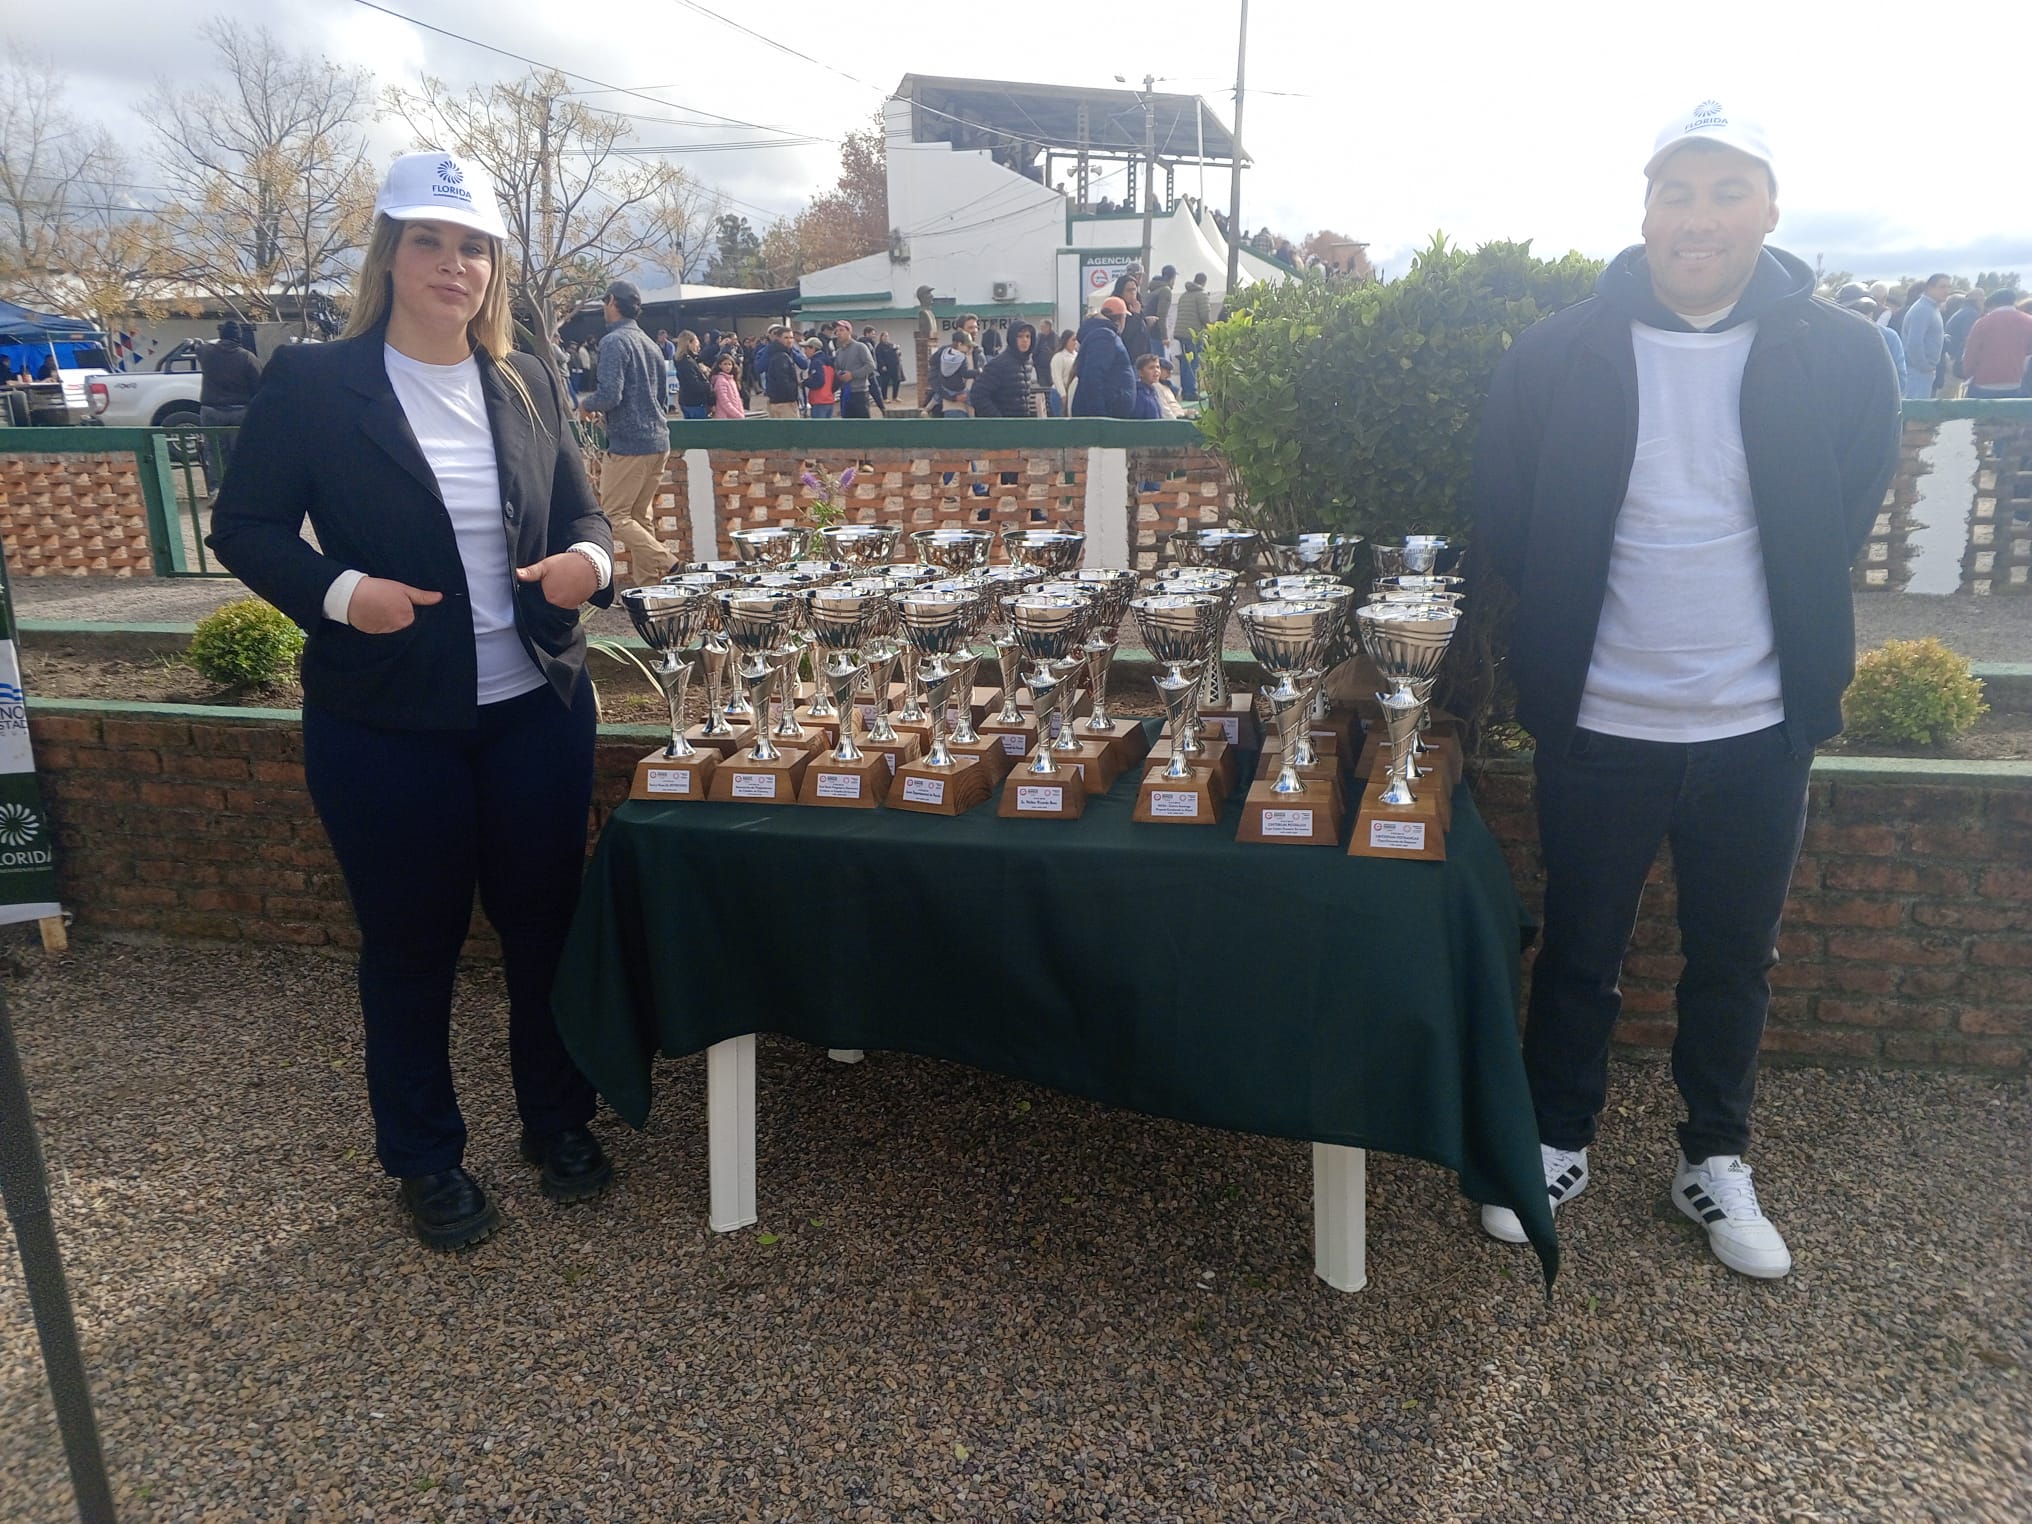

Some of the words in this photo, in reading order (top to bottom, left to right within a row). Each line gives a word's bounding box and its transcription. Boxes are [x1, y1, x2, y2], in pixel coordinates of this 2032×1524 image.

[1684, 117, 1729, 130] FLORIDA
[432, 184, 472, 199] FLORIDA
[1087, 256, 1131, 265] AGENCIA
